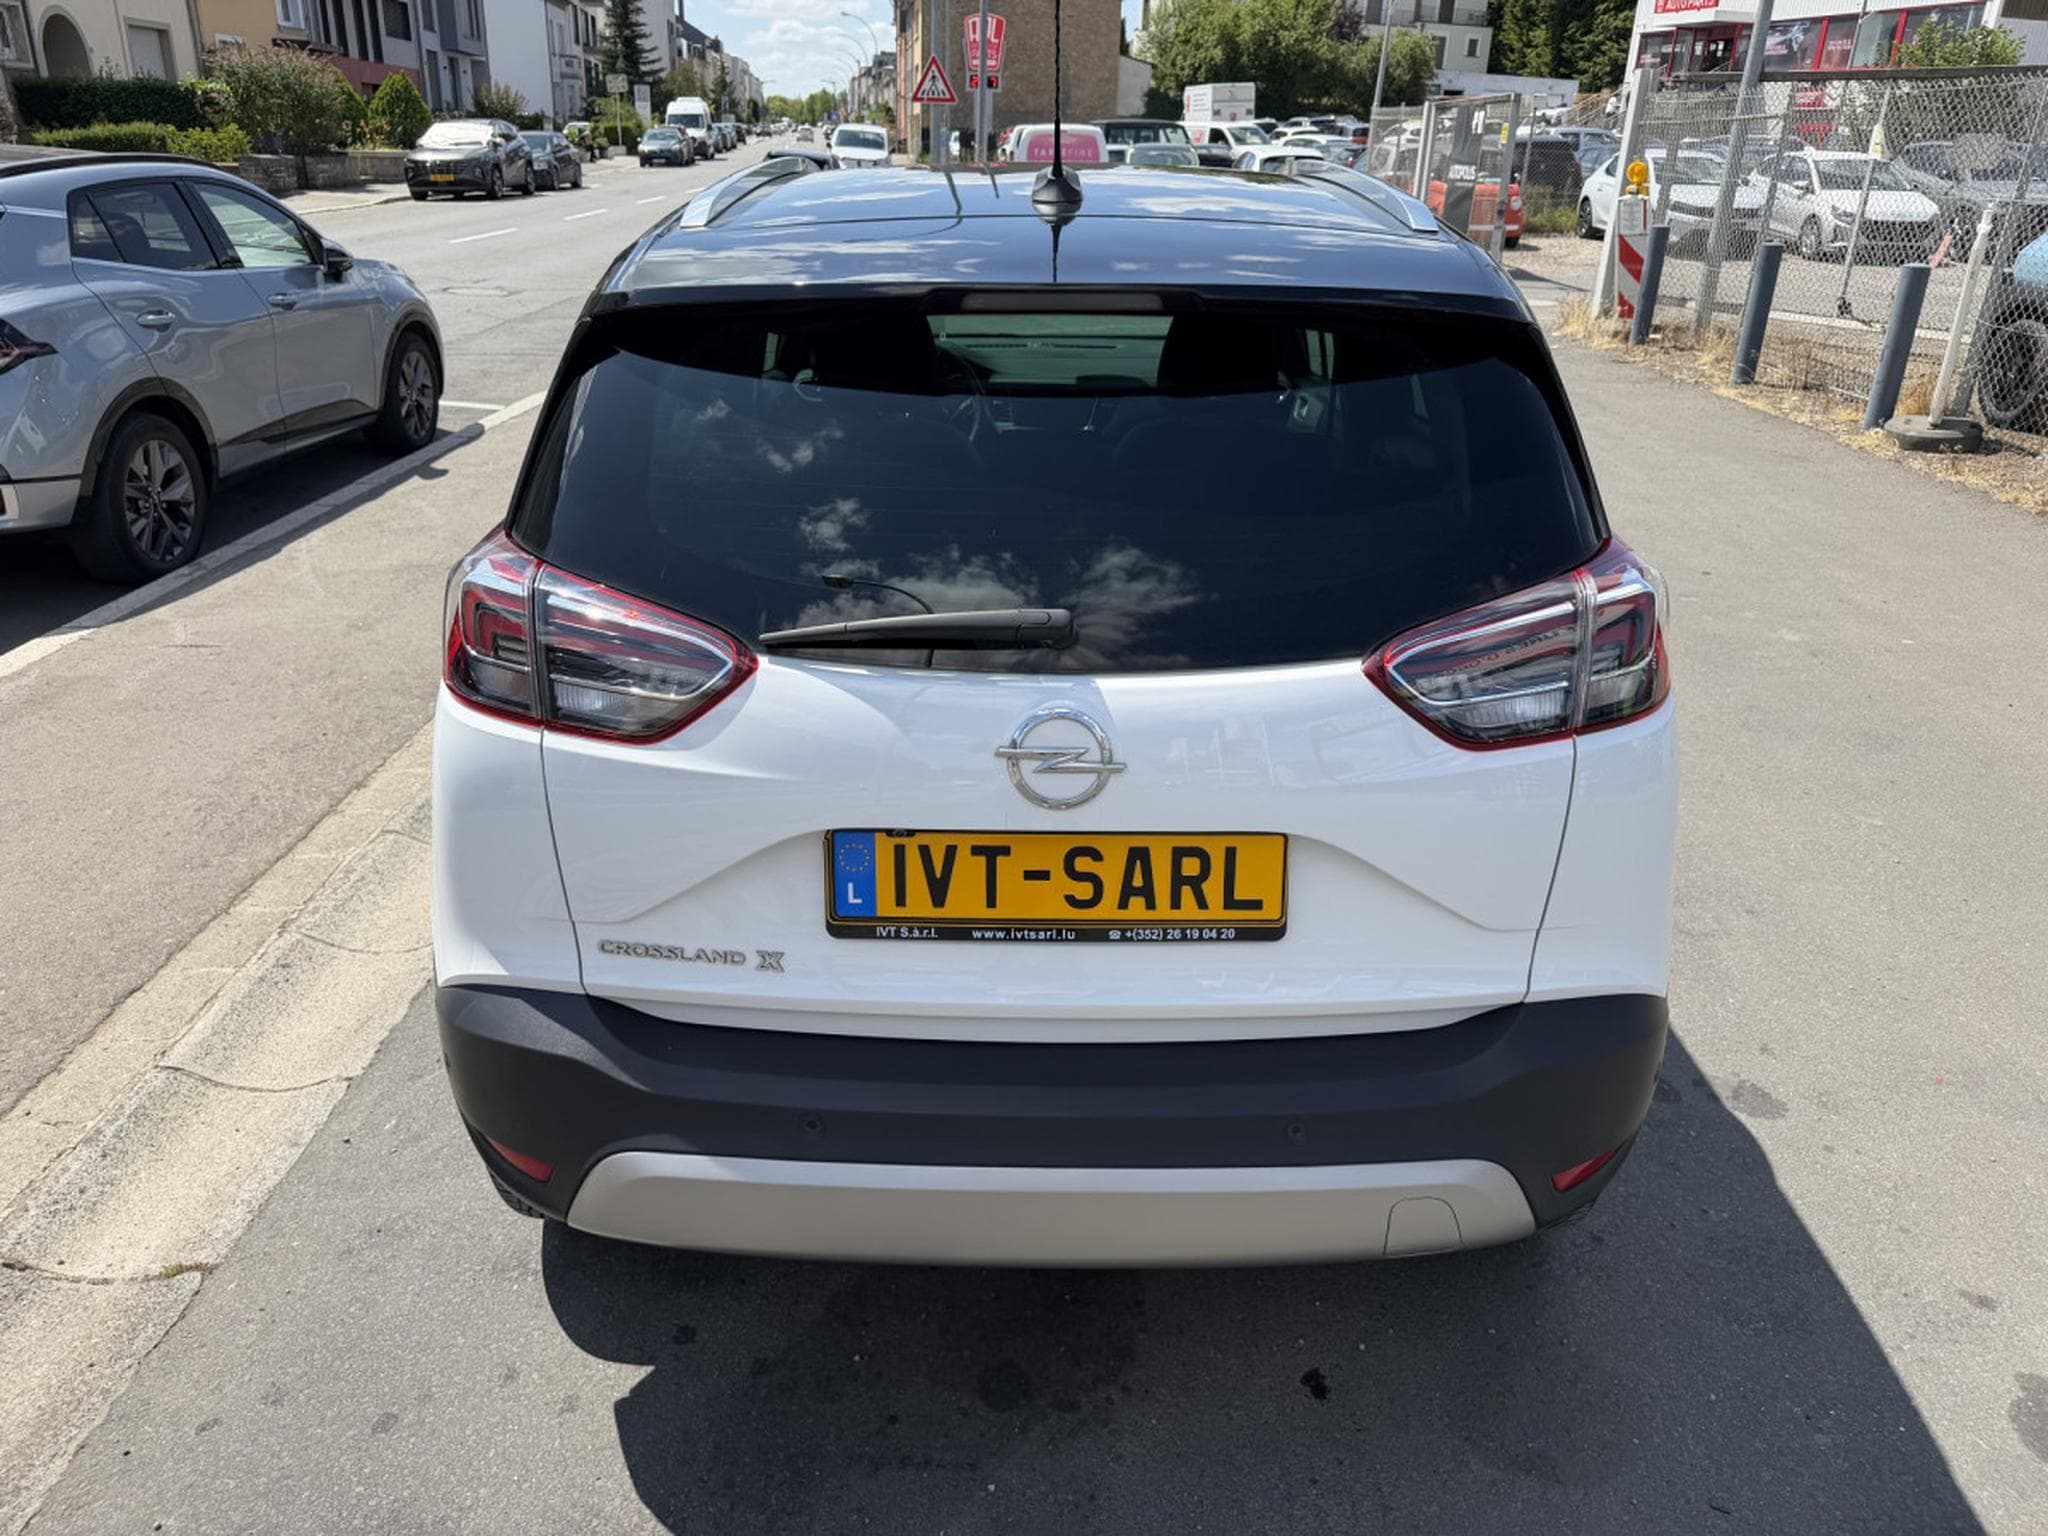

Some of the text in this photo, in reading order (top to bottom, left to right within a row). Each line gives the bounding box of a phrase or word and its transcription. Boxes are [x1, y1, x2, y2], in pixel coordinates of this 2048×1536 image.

[893, 844, 1263, 911] IVT-SARL
[848, 882, 863, 904] L
[876, 926, 938, 938] IVT S.à.r.l.
[972, 928, 1076, 940] www.ivtsarl.lu
[1125, 928, 1236, 941] +(352) 26 19 04 20
[598, 939, 786, 973] CROSSLAND X
